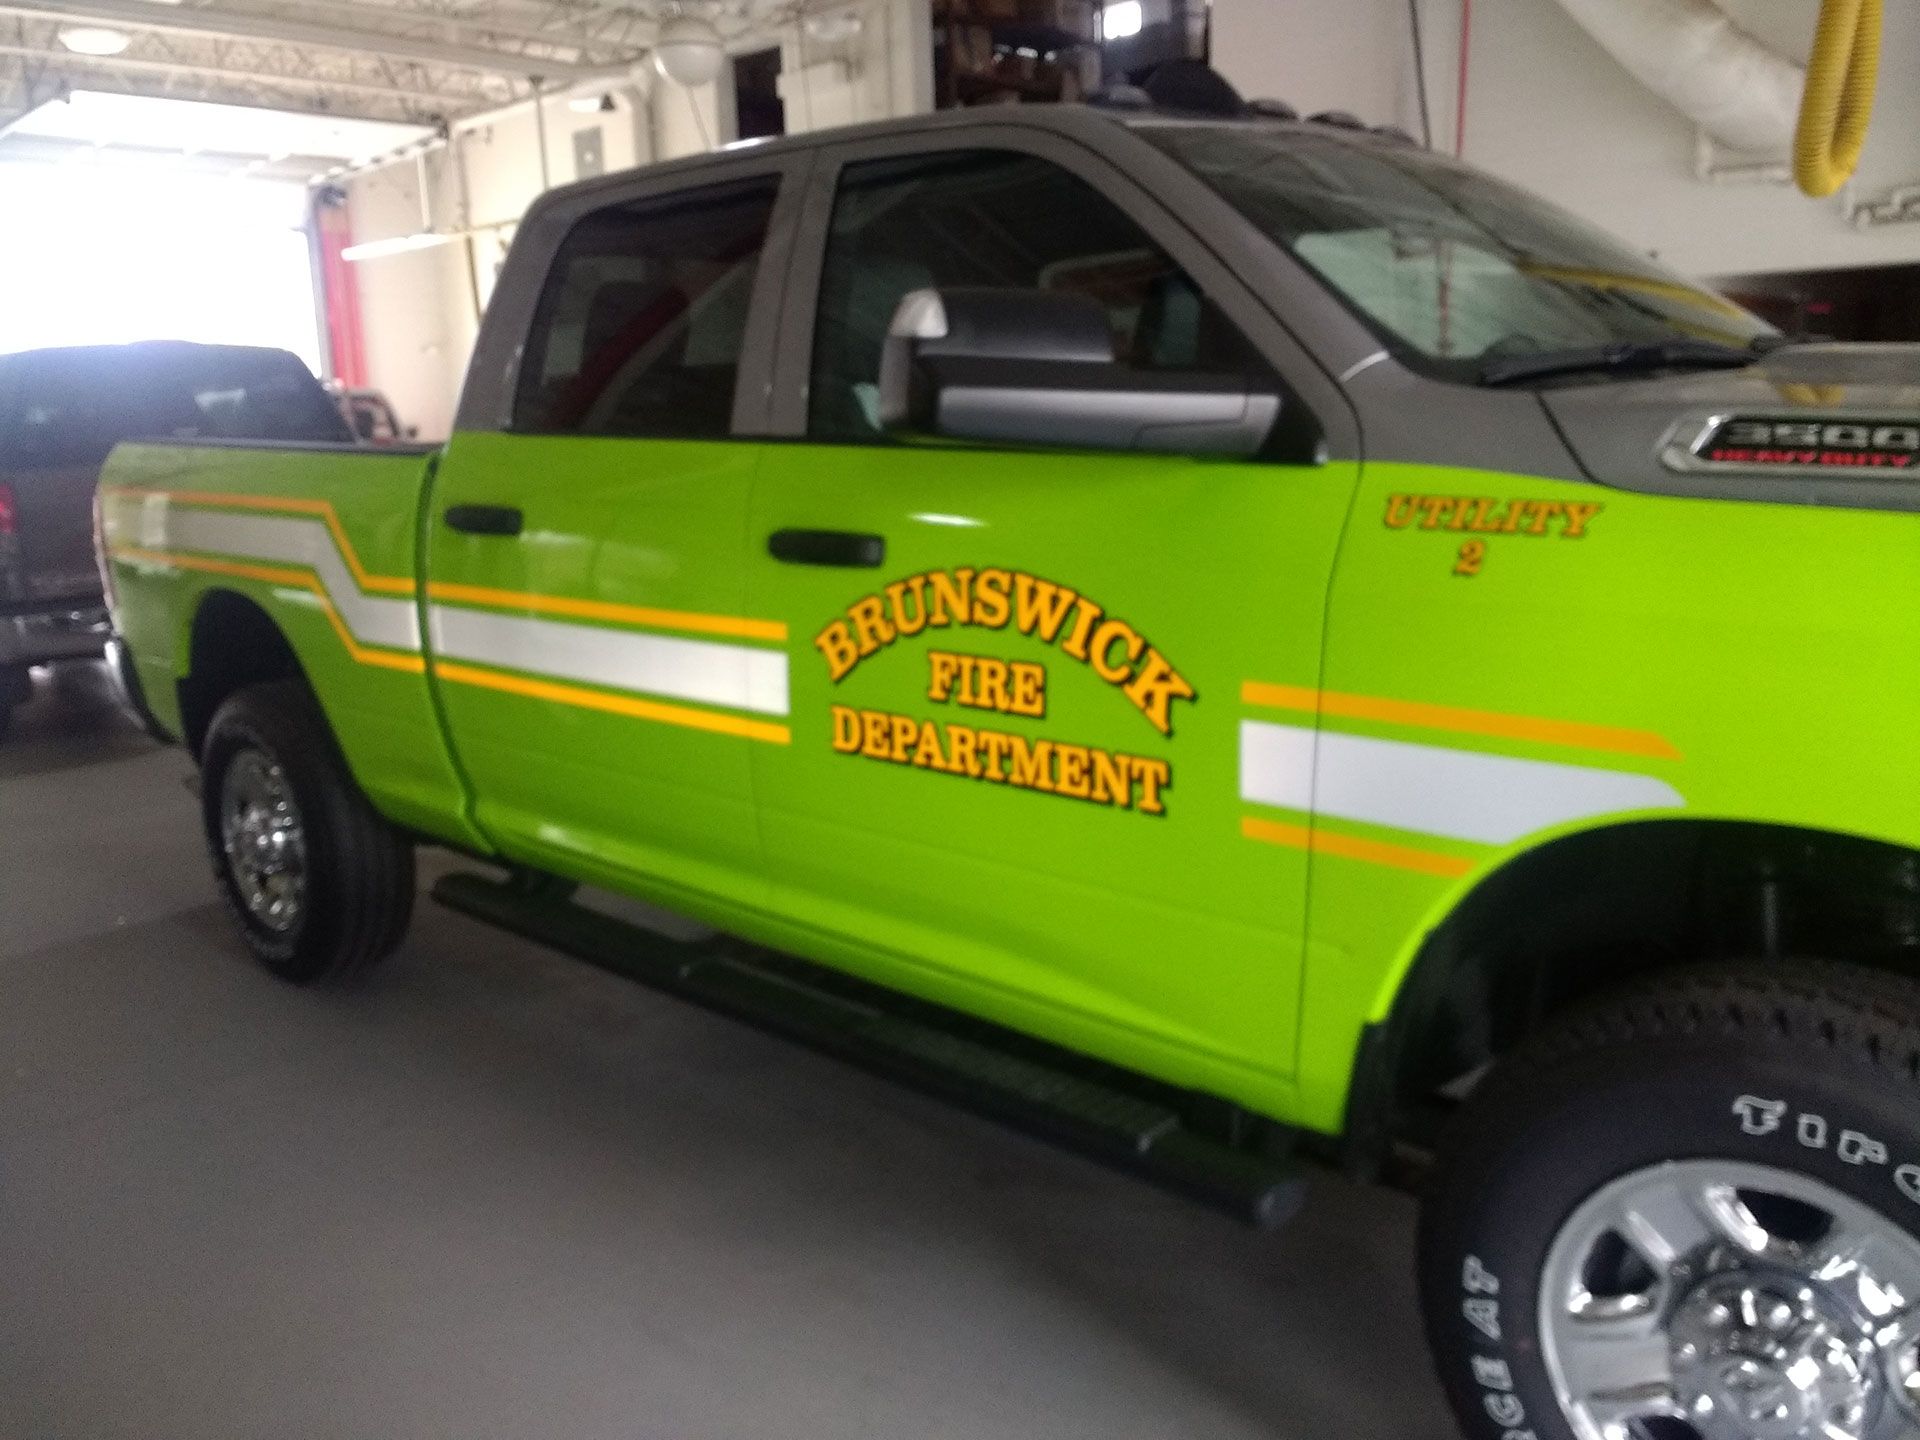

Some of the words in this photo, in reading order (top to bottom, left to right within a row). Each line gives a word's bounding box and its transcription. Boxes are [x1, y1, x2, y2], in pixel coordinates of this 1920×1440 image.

[1711, 447, 1816, 463] HEAVY
[1820, 450, 1912, 467] DUTY
[1722, 422, 1920, 450] 3500
[1384, 492, 1603, 538] UTILITY
[1453, 538, 1486, 576] 2
[815, 566, 1199, 738] BRUNSWICK
[927, 649, 1046, 719] FIRE
[830, 703, 1173, 817] DEPARTMENT
